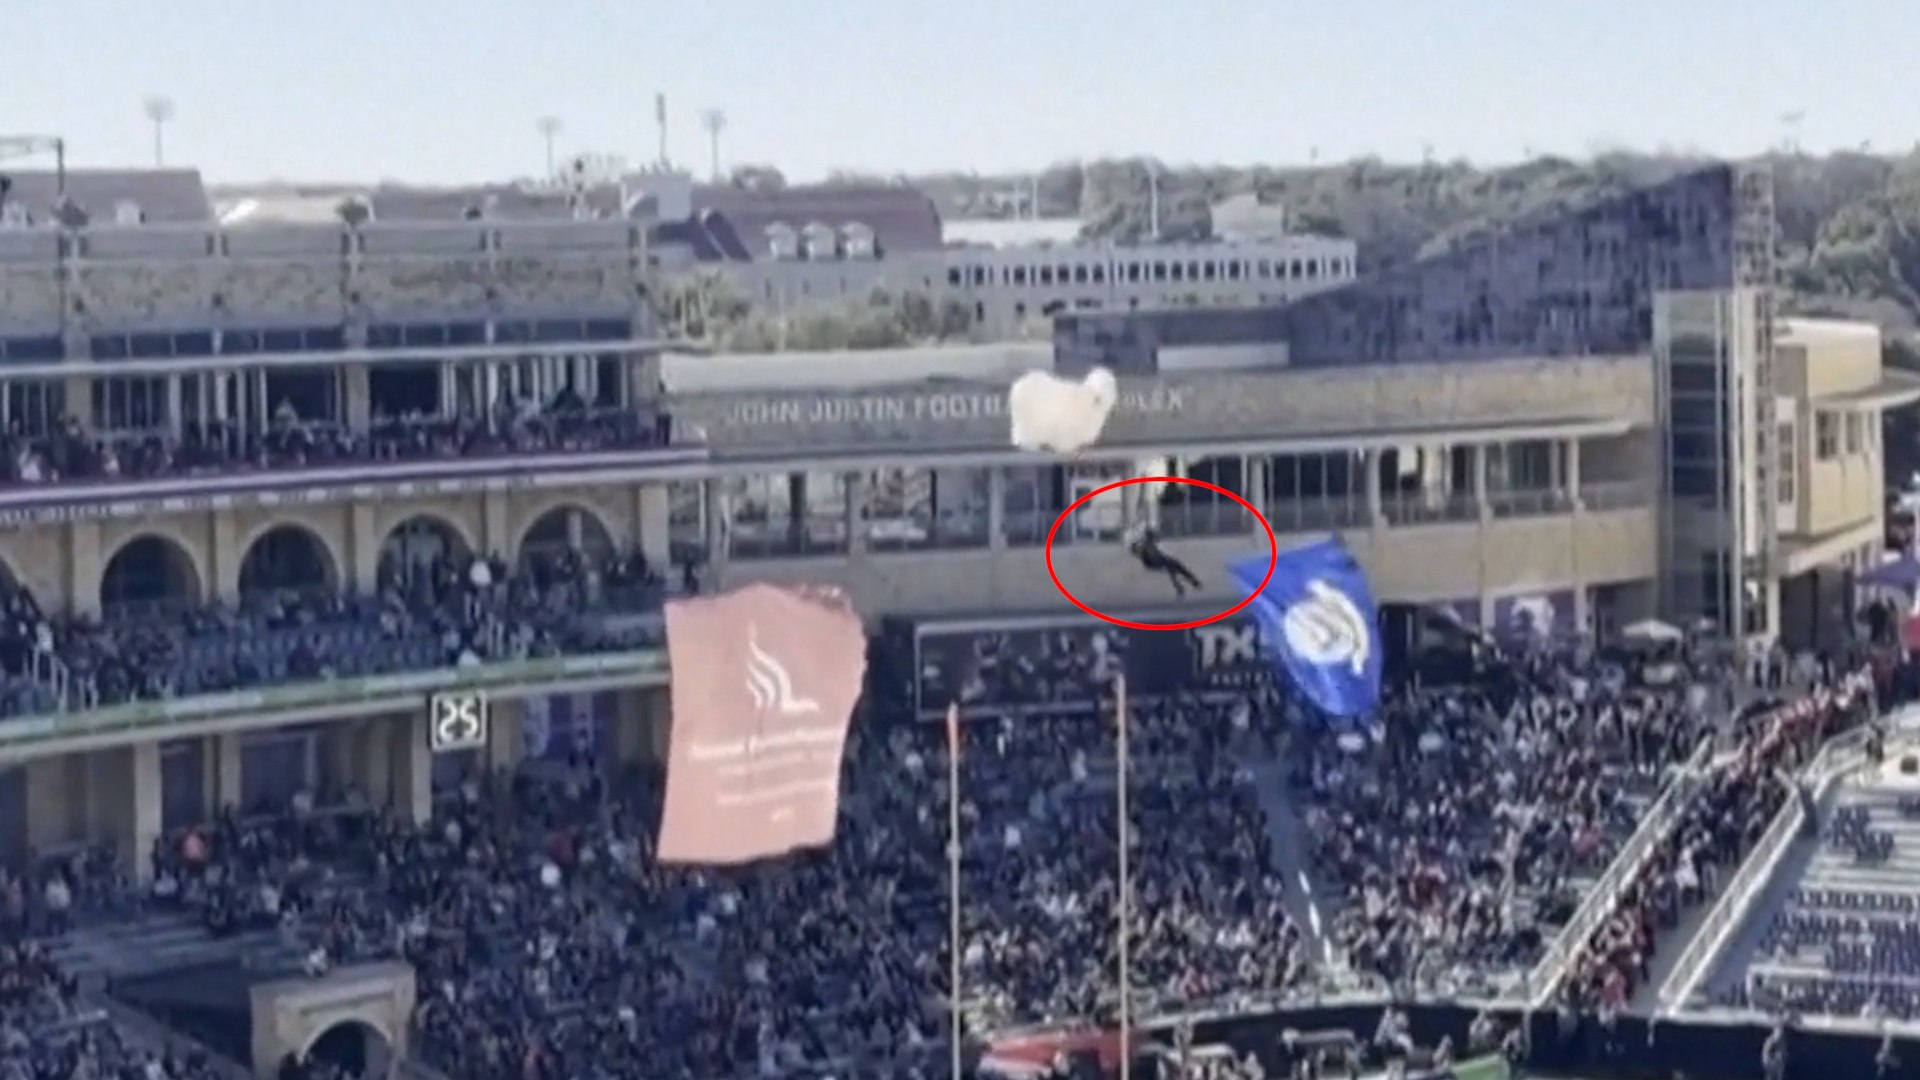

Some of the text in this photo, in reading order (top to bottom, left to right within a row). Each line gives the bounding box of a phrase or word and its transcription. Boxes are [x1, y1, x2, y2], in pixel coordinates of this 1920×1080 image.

[727, 400, 799, 424] JOHN
[809, 397, 904, 422] JUSTIN
[914, 394, 1009, 420] FOOTB
[439, 699, 479, 741] 25
